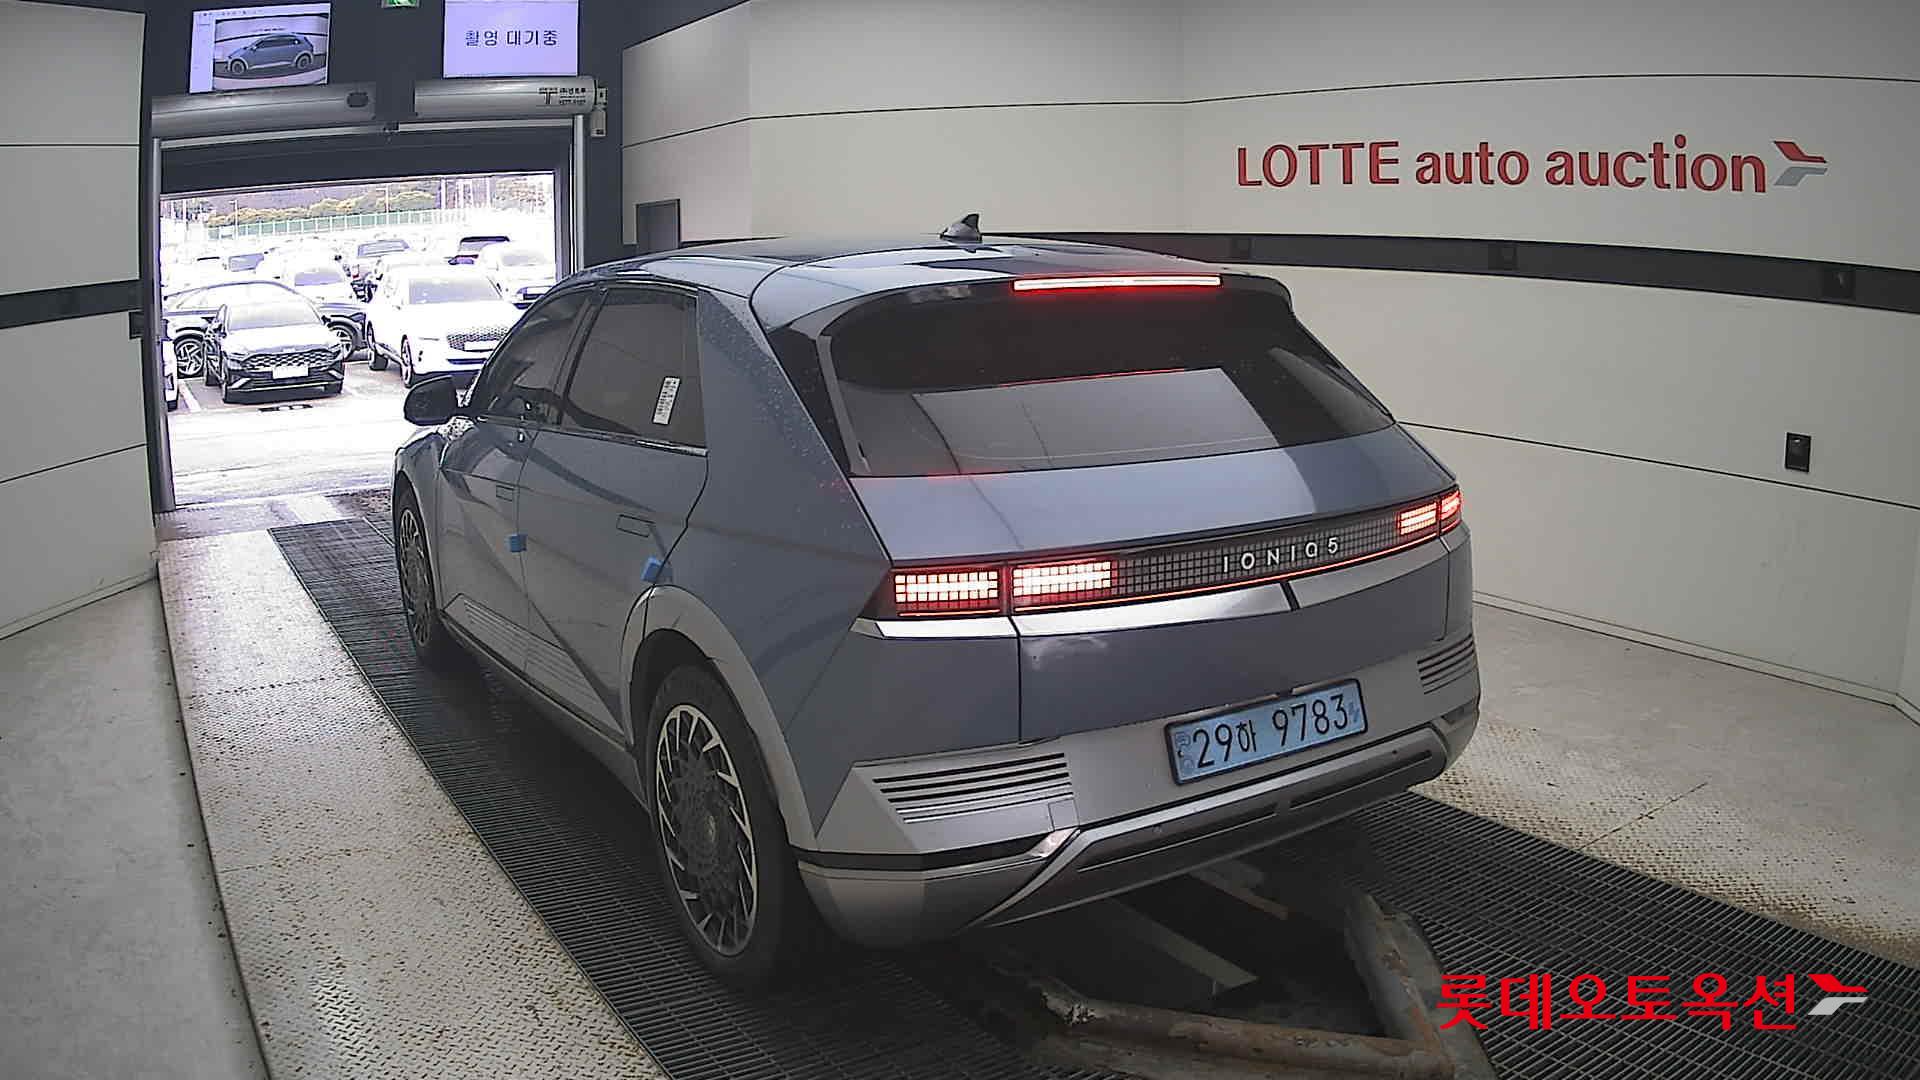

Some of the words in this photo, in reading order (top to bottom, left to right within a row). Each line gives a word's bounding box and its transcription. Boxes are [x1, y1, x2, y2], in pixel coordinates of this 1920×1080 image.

[465, 29, 498, 47] 촬영
[1237, 141, 1400, 187] LOTTE
[1415, 141, 1530, 185] auto
[1545, 134, 1767, 193] auction
[1193, 720, 1257, 768] 29하
[1272, 694, 1348, 747] 9783
